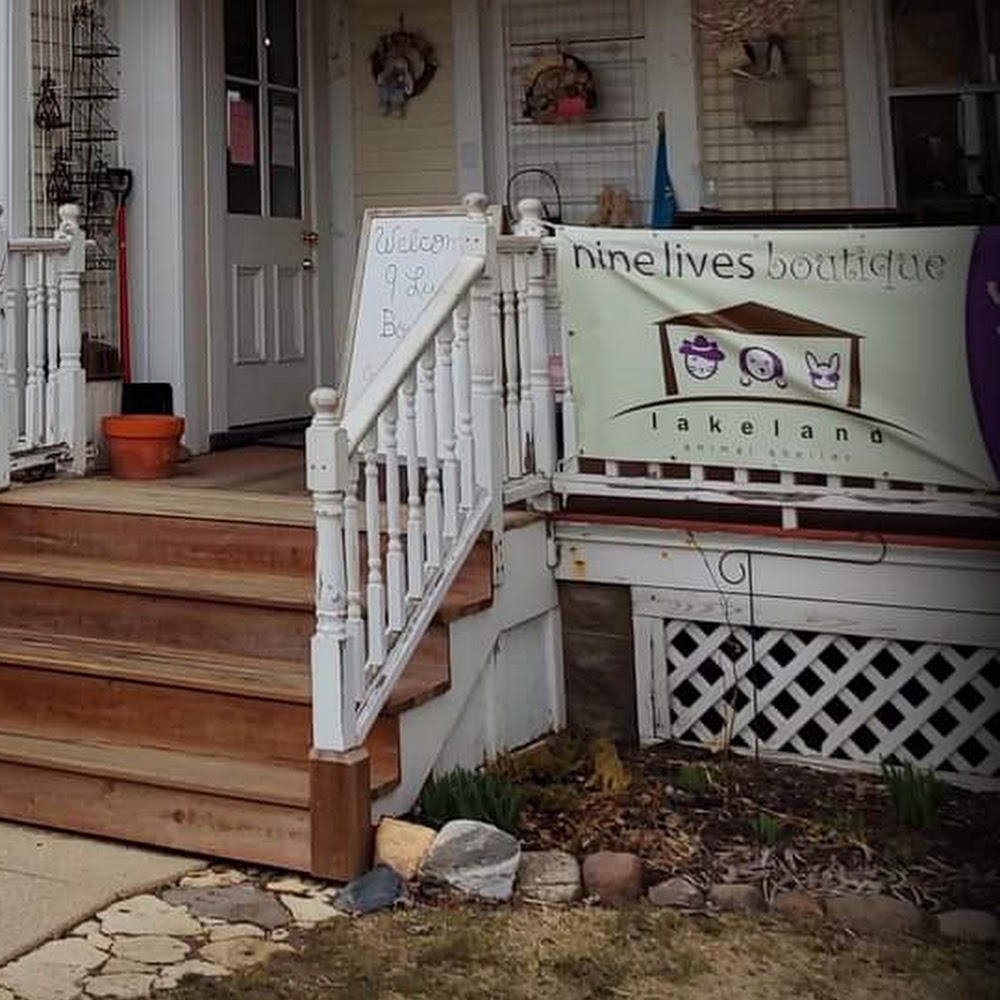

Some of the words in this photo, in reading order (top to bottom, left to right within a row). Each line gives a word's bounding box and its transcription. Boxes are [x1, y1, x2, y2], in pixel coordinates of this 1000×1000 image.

[376, 225, 455, 254] Welcom
[573, 242, 655, 277] nine
[664, 243, 756, 279] lives
[766, 241, 947, 290] boutique
[652, 412, 883, 444] lakeland
